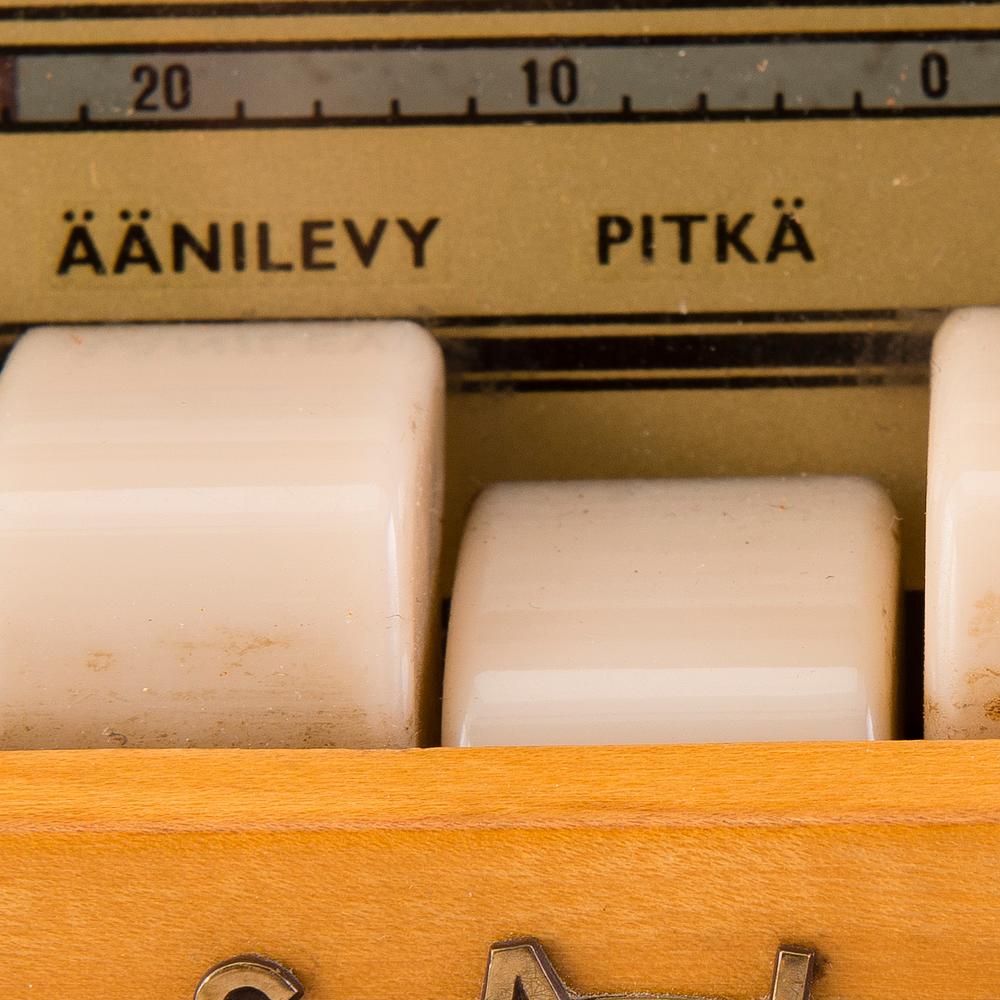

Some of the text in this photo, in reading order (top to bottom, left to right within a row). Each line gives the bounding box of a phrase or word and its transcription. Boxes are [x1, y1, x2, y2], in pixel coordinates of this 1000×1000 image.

[132, 63, 192, 112] 20
[521, 58, 578, 106] 10
[921, 52, 950, 99] 0
[57, 209, 441, 276] ÄÄNILEVY
[597, 197, 815, 264] PITKÄ
